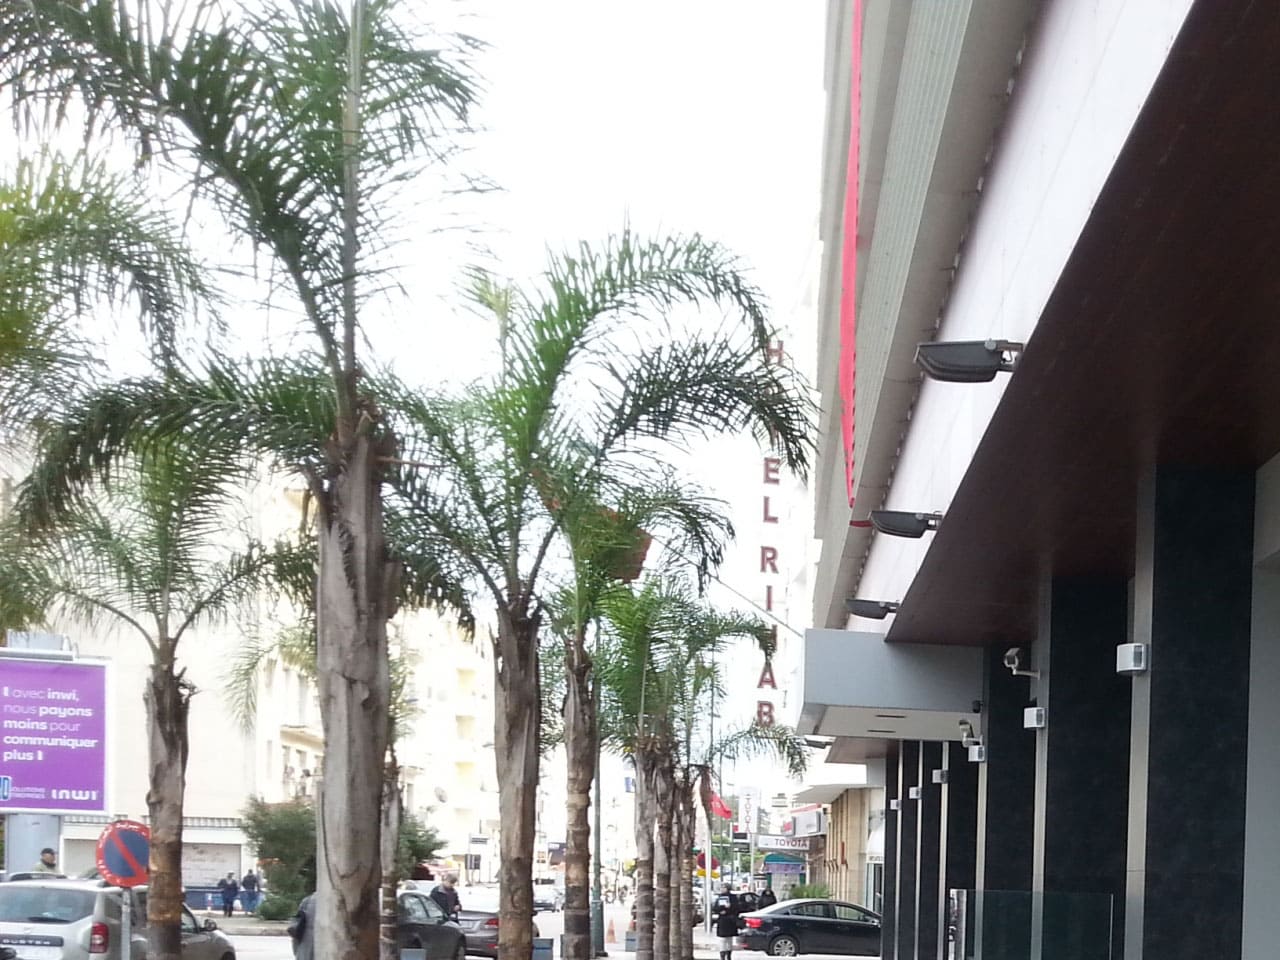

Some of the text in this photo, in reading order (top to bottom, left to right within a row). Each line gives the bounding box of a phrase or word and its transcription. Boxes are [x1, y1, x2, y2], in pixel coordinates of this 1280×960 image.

[763, 340, 784, 524] HEL
[12, 687, 80, 702] avec inwi,
[3, 704, 94, 718] nous payons
[3, 718, 81, 732] moins pour
[3, 735, 98, 749] communiquer
[3, 749, 34, 762] plus
[775, 838, 808, 848] TOYOTA
